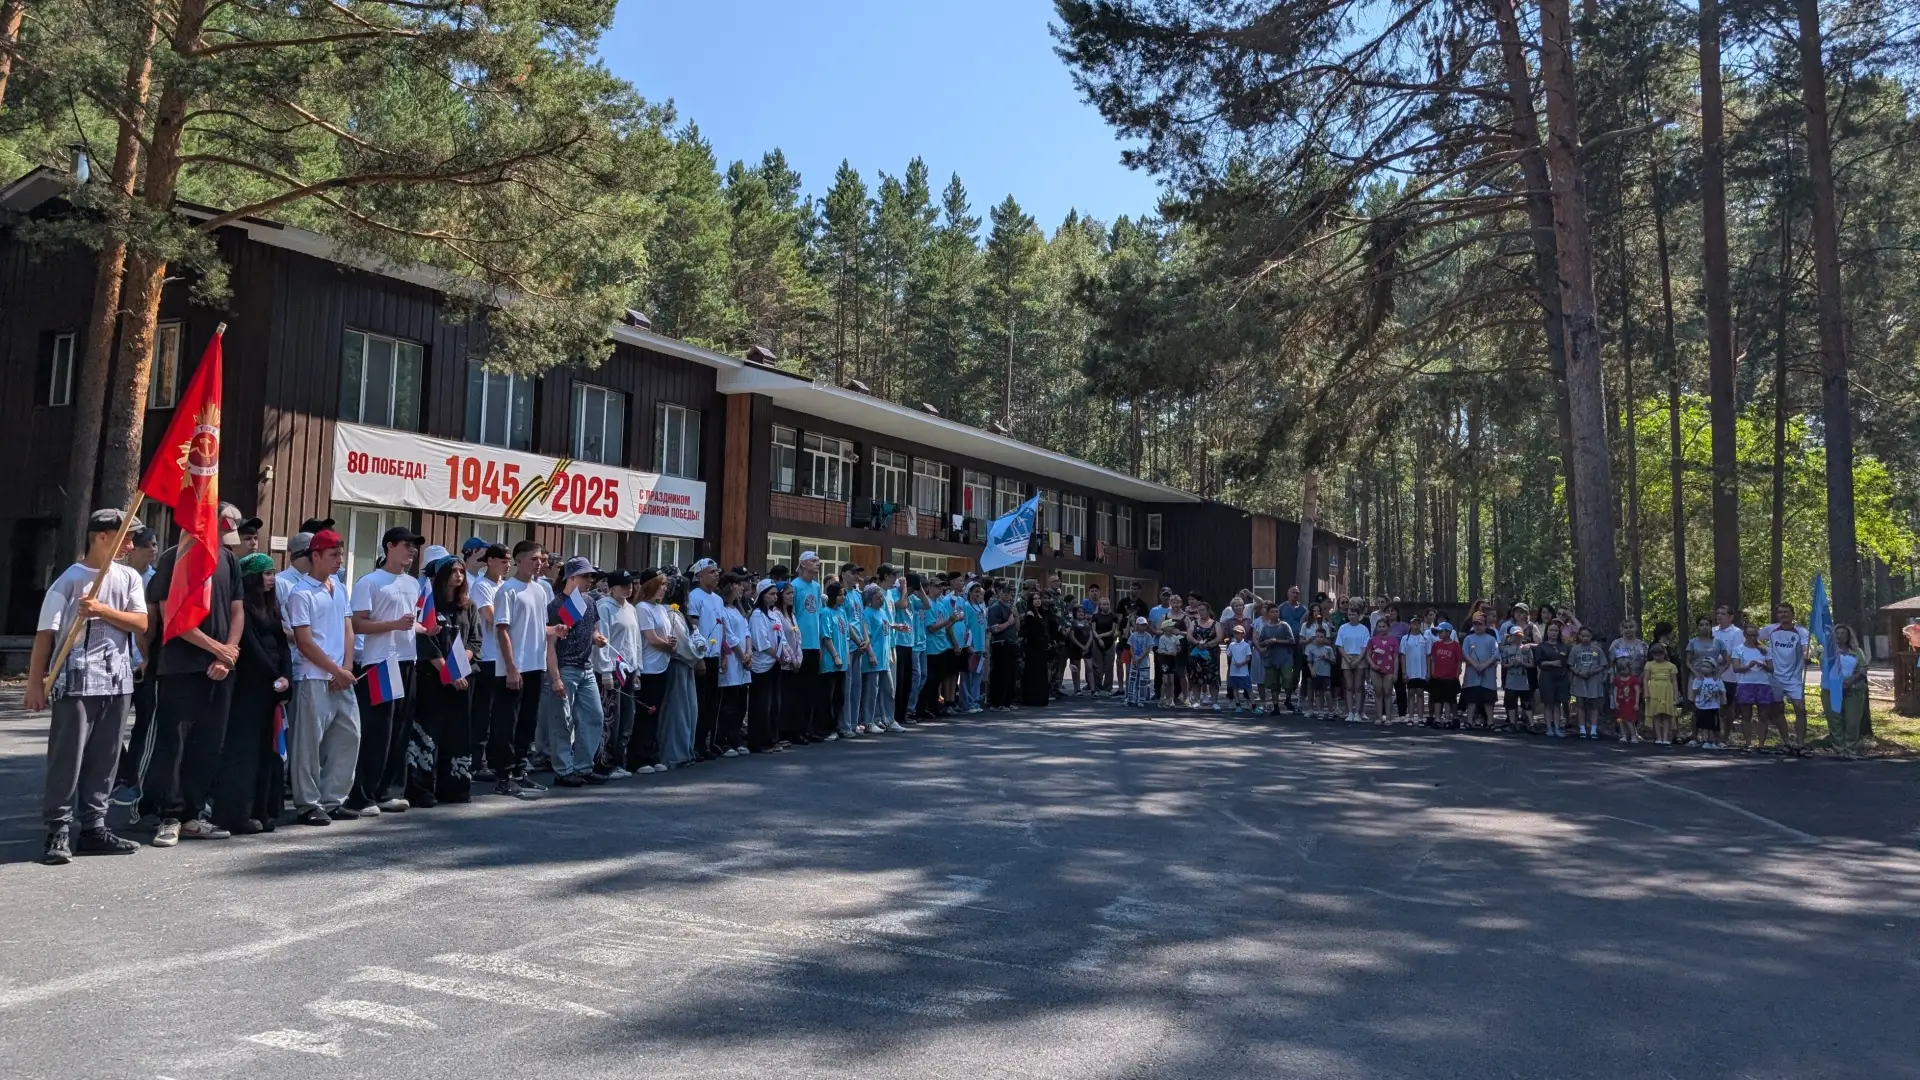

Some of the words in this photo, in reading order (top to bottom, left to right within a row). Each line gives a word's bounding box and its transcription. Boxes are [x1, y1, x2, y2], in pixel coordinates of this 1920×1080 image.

[347, 451, 369, 474] 80
[371, 457, 427, 480] ПОБЕДА!
[446, 455, 520, 506] 1945
[552, 471, 619, 519] 2025
[639, 489, 645, 500] С
[646, 490, 691, 506] ПРАЗДНИКОМ
[638, 503, 670, 518] ВЕЛИКОЙ
[671, 507, 700, 521] ПОБЕДЫ!
[1774, 640, 1794, 649] bwin
